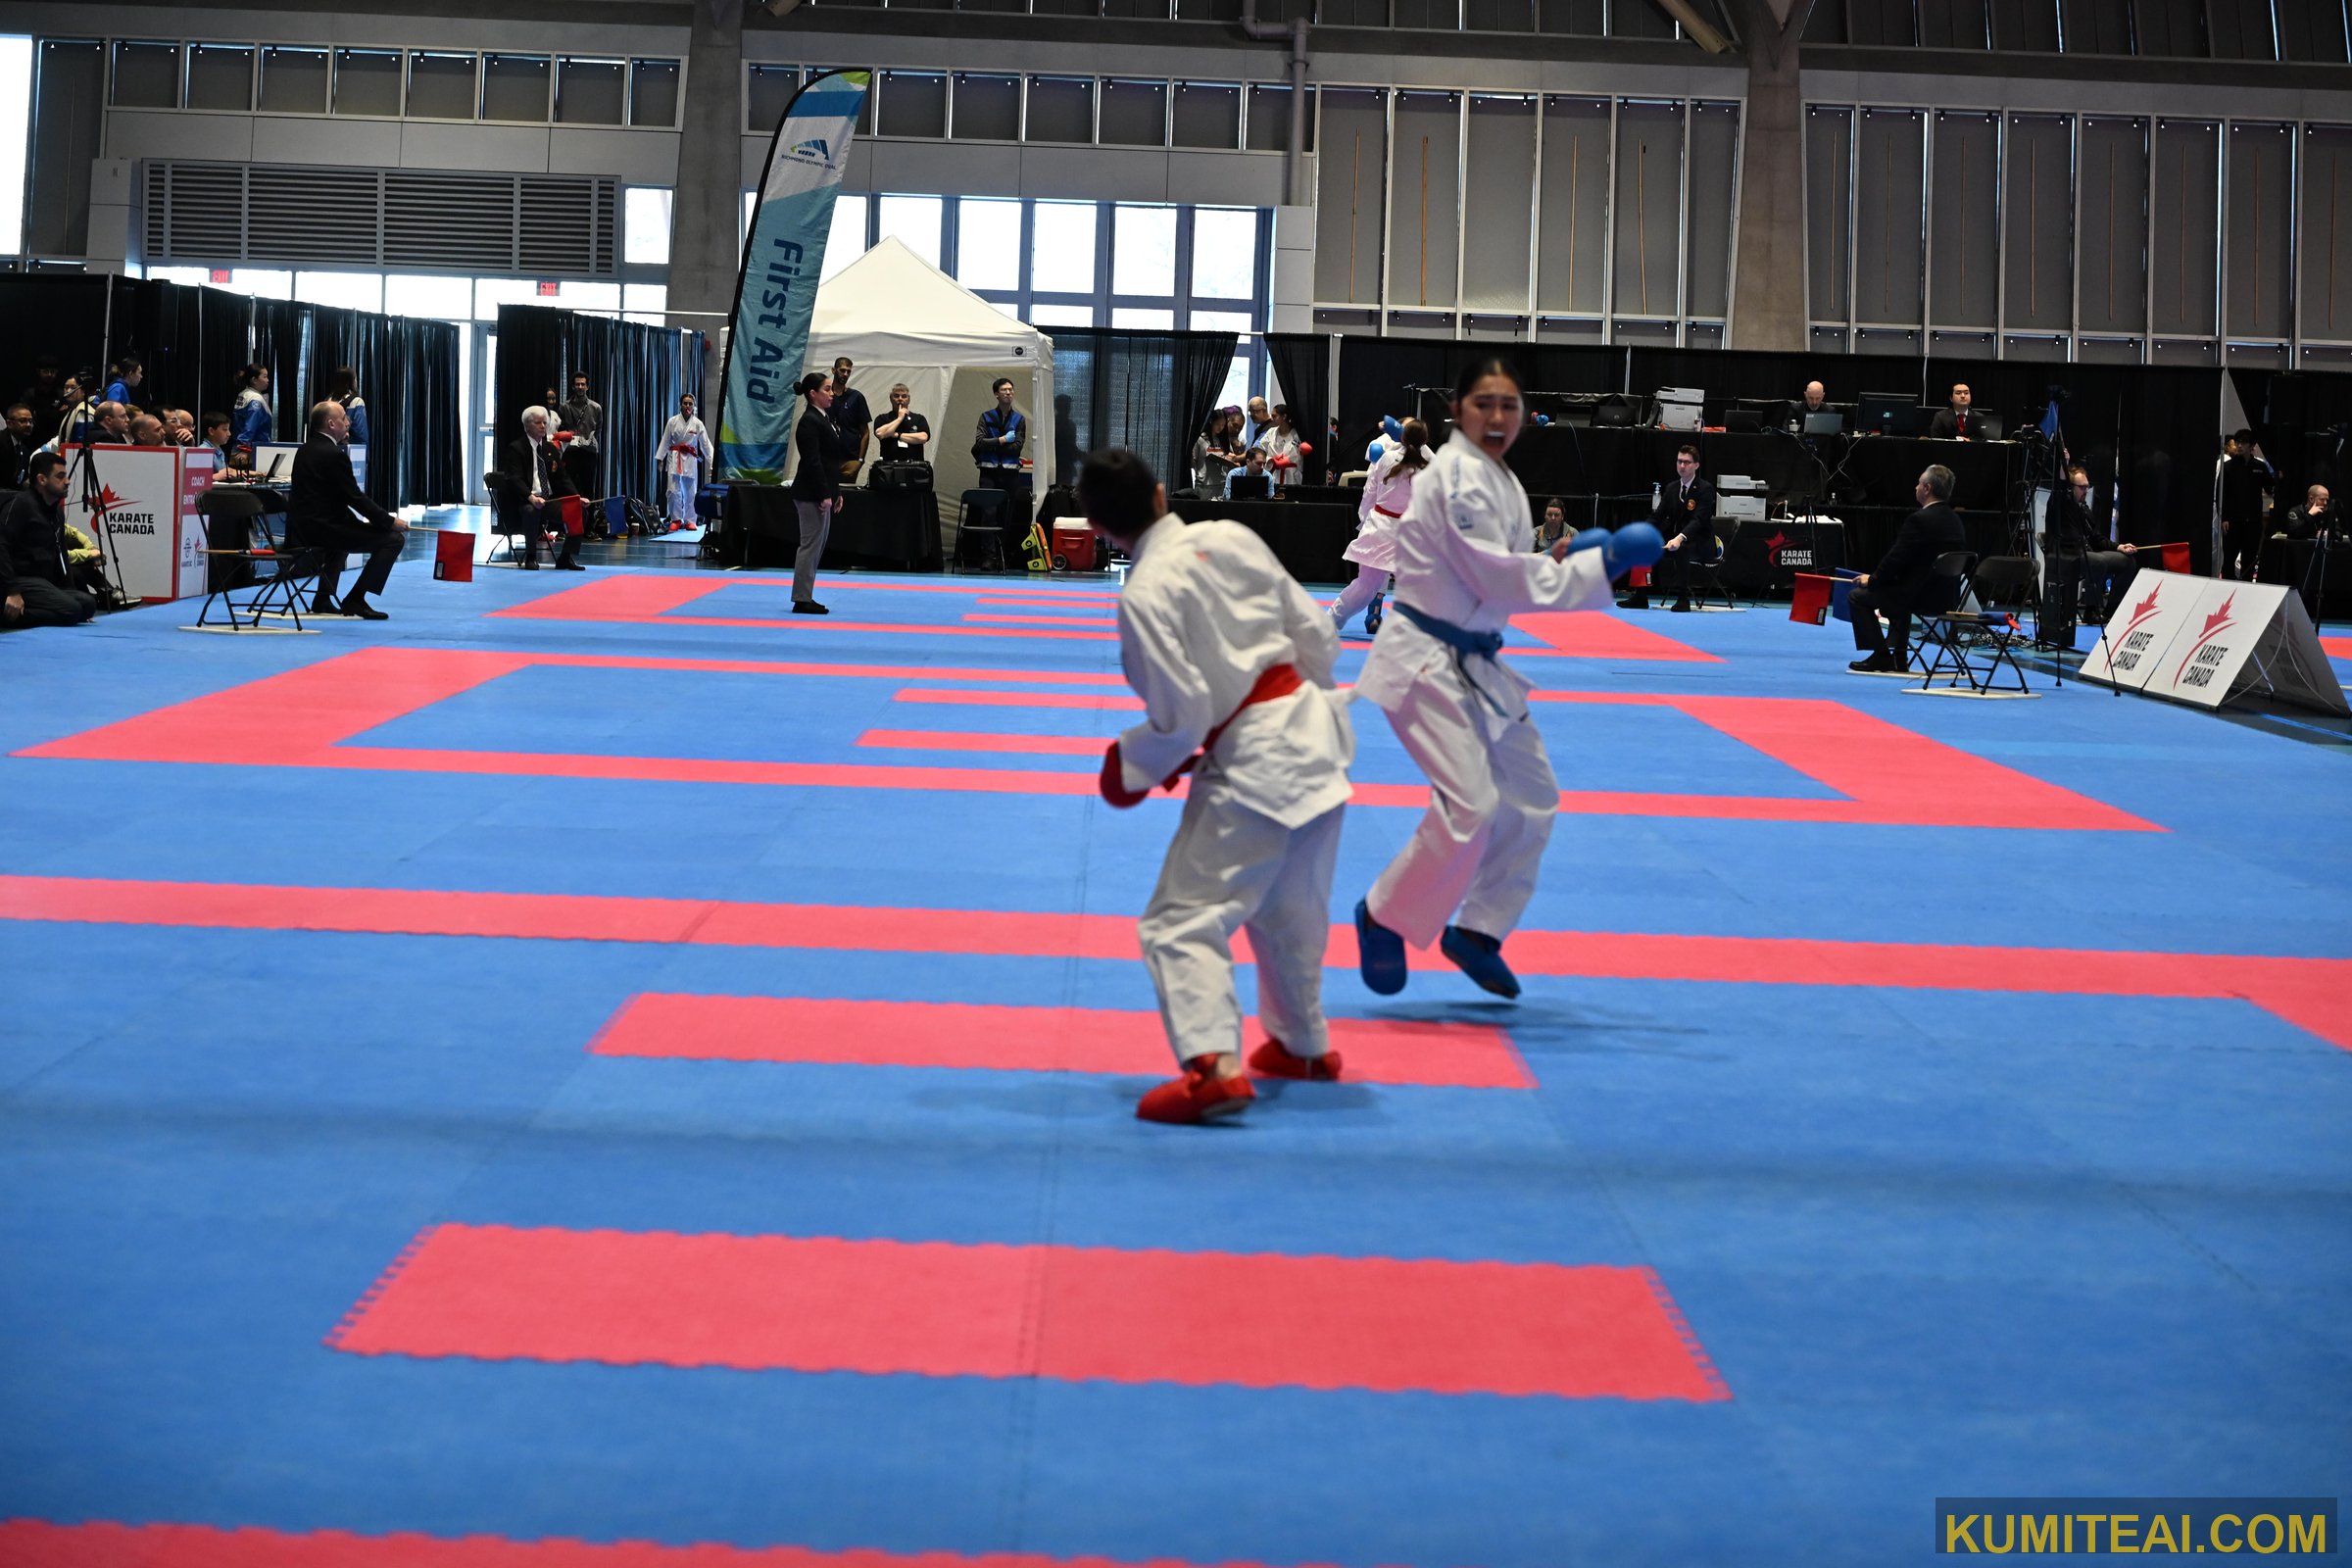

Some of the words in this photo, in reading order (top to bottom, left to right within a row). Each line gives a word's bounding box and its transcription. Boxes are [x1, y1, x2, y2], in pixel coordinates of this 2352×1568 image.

[781, 154, 806, 165] RICHMOND
[806, 158, 825, 169] OLYMPIC
[759, 238, 804, 328] First
[747, 337, 784, 404] Aid
[109, 513, 155, 524] KARATE
[109, 523, 155, 535] CANADA
[1781, 550, 1812, 559] KARATE
[2124, 630, 2154, 652] KARATE
[2112, 650, 2141, 671] CANADA
[2195, 644, 2229, 666] KARATE
[2181, 665, 2215, 688] CANADA
